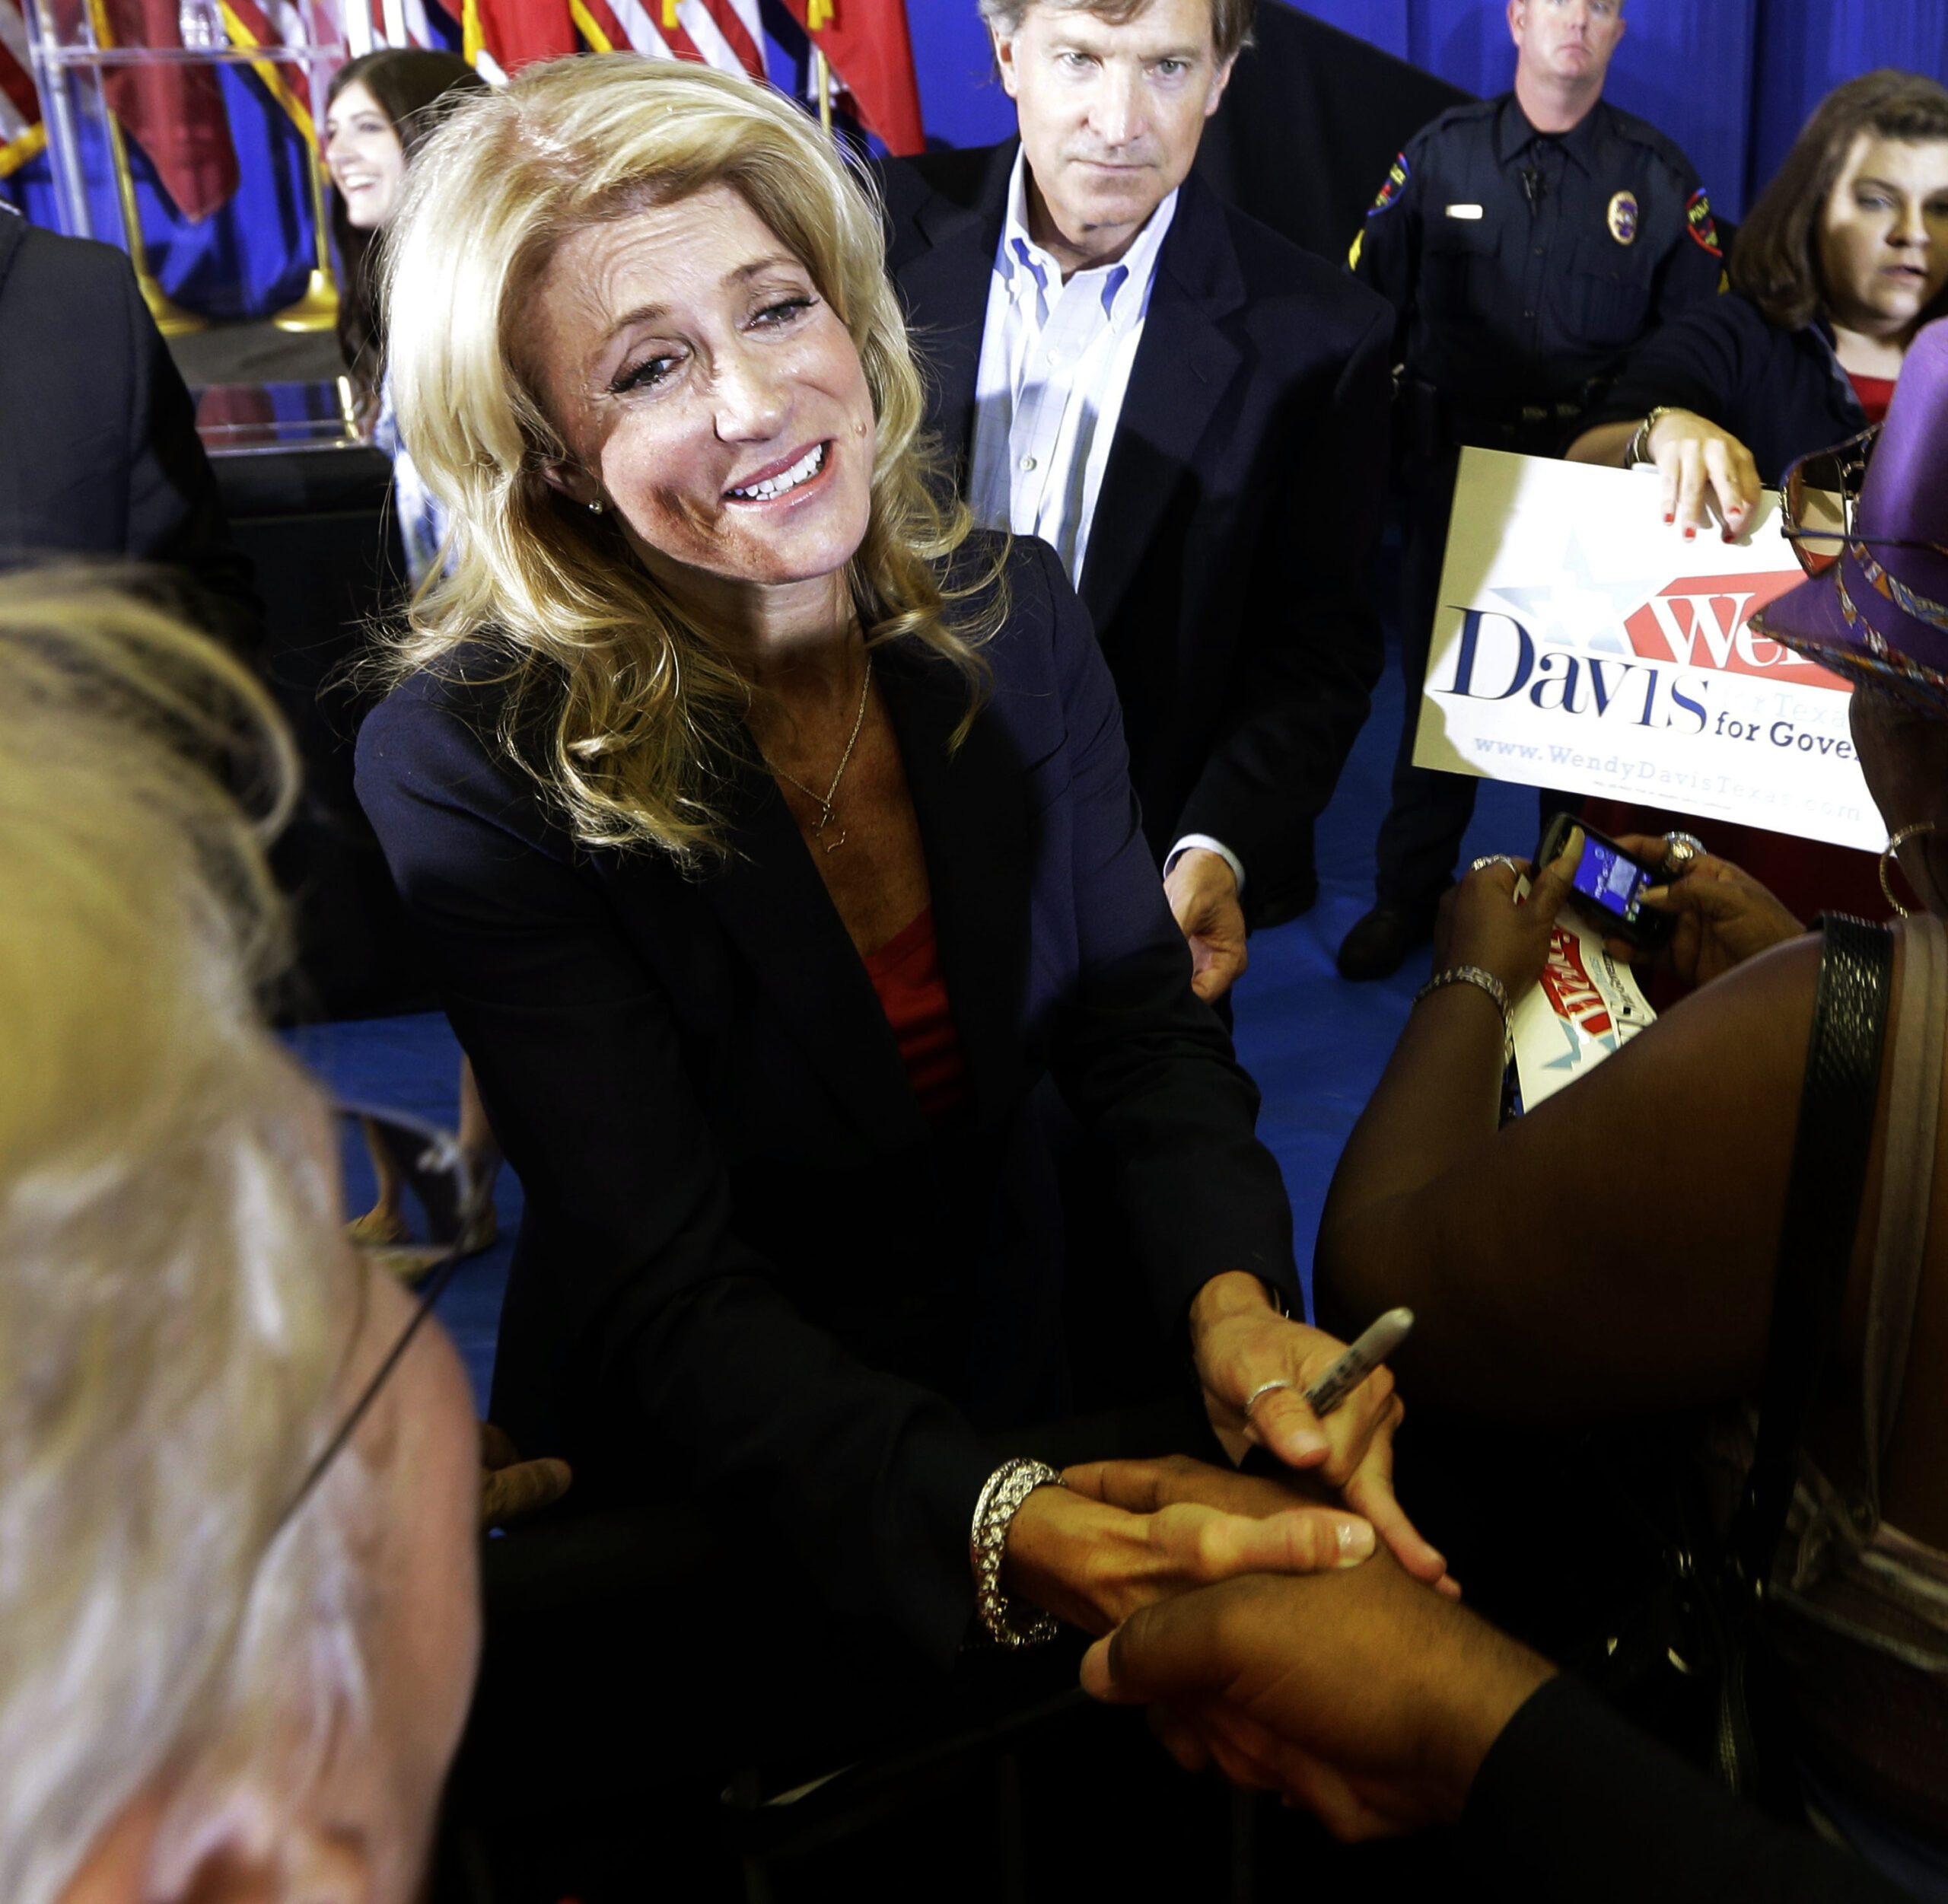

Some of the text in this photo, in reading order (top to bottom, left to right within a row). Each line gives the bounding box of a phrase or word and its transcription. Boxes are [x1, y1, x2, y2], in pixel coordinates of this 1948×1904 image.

[1652, 591, 1819, 670] We
[1714, 712, 1860, 762] for Gove
[1774, 693, 1847, 728] Texa
[1474, 737, 1861, 822] www.WendyDavisTexas.com
